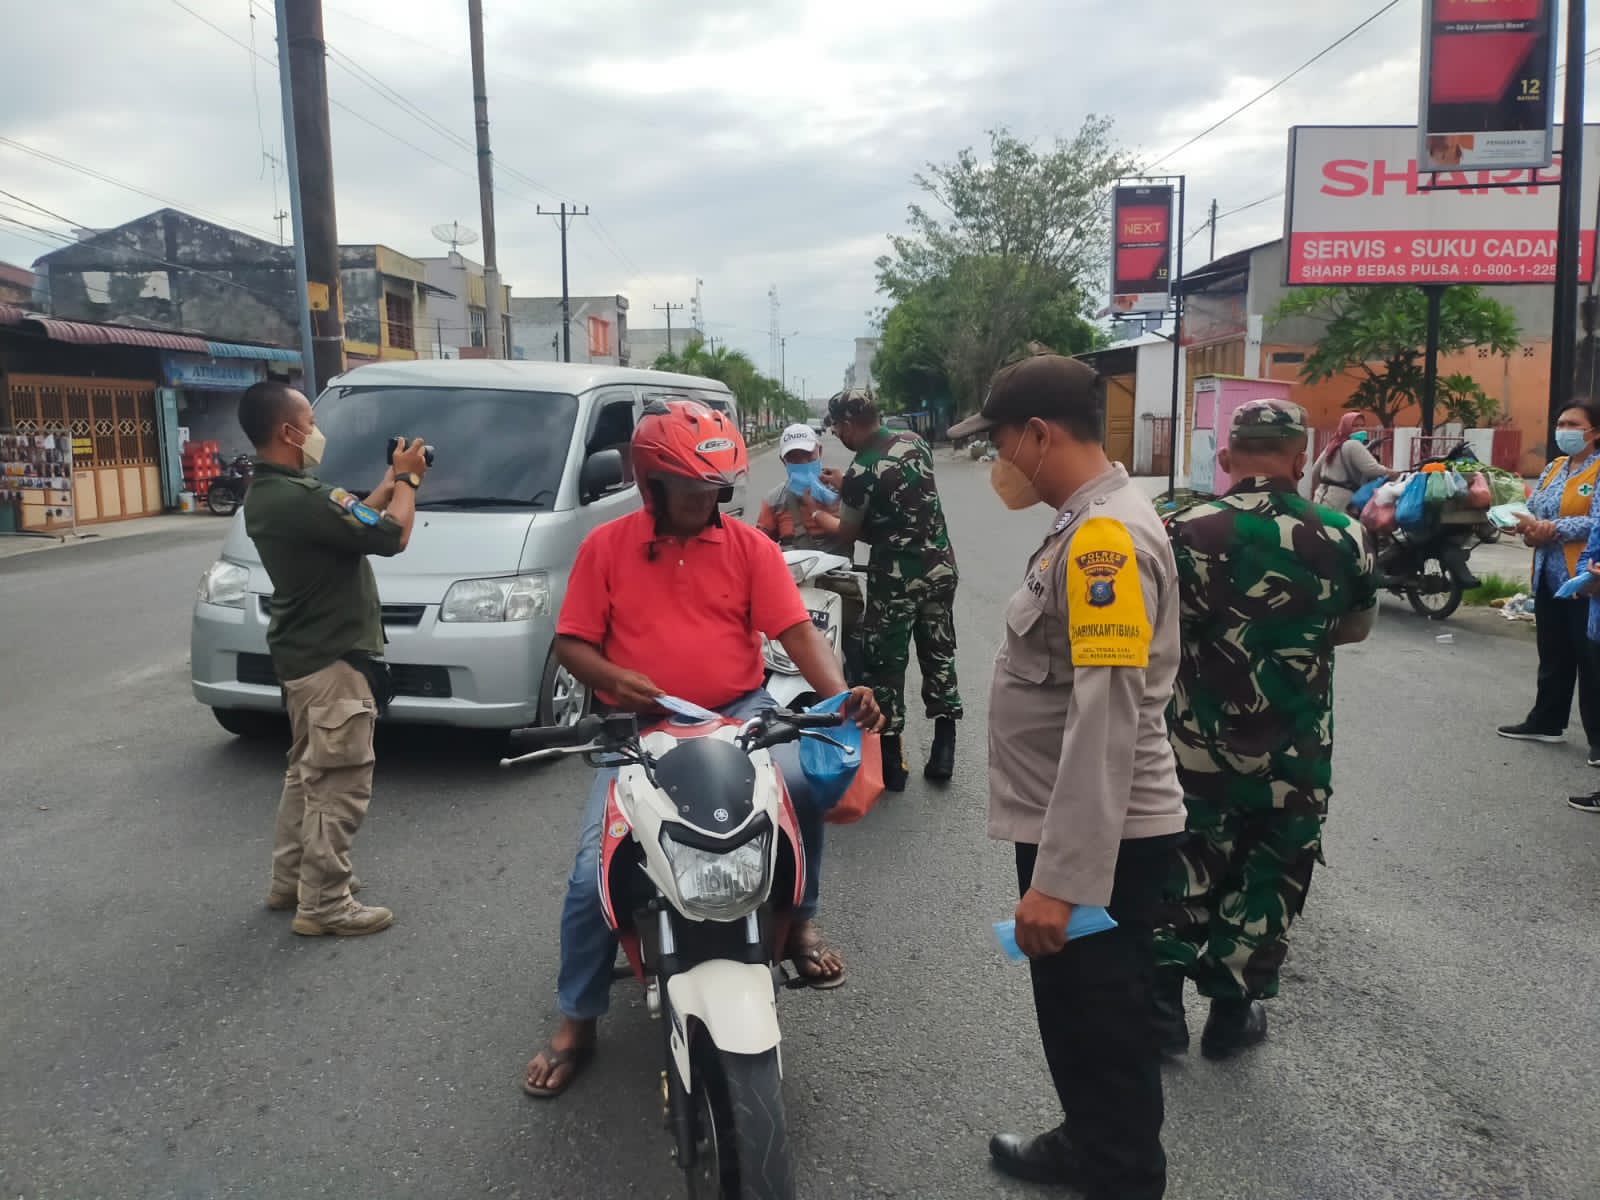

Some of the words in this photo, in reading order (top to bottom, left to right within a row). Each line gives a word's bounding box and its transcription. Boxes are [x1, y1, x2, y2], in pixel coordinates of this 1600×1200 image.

[1521, 80, 1540, 95] 12
[1124, 222, 1162, 237] NEXT
[1303, 240, 1386, 259] SERVIS
[1411, 239, 1476, 258] SUKU
[1483, 238, 1583, 258] CADAN
[1302, 264, 1352, 278] SHARP
[1357, 263, 1407, 277] BEBAS
[1411, 263, 1459, 277] PULSA
[1080, 551, 1121, 563] POLRES
